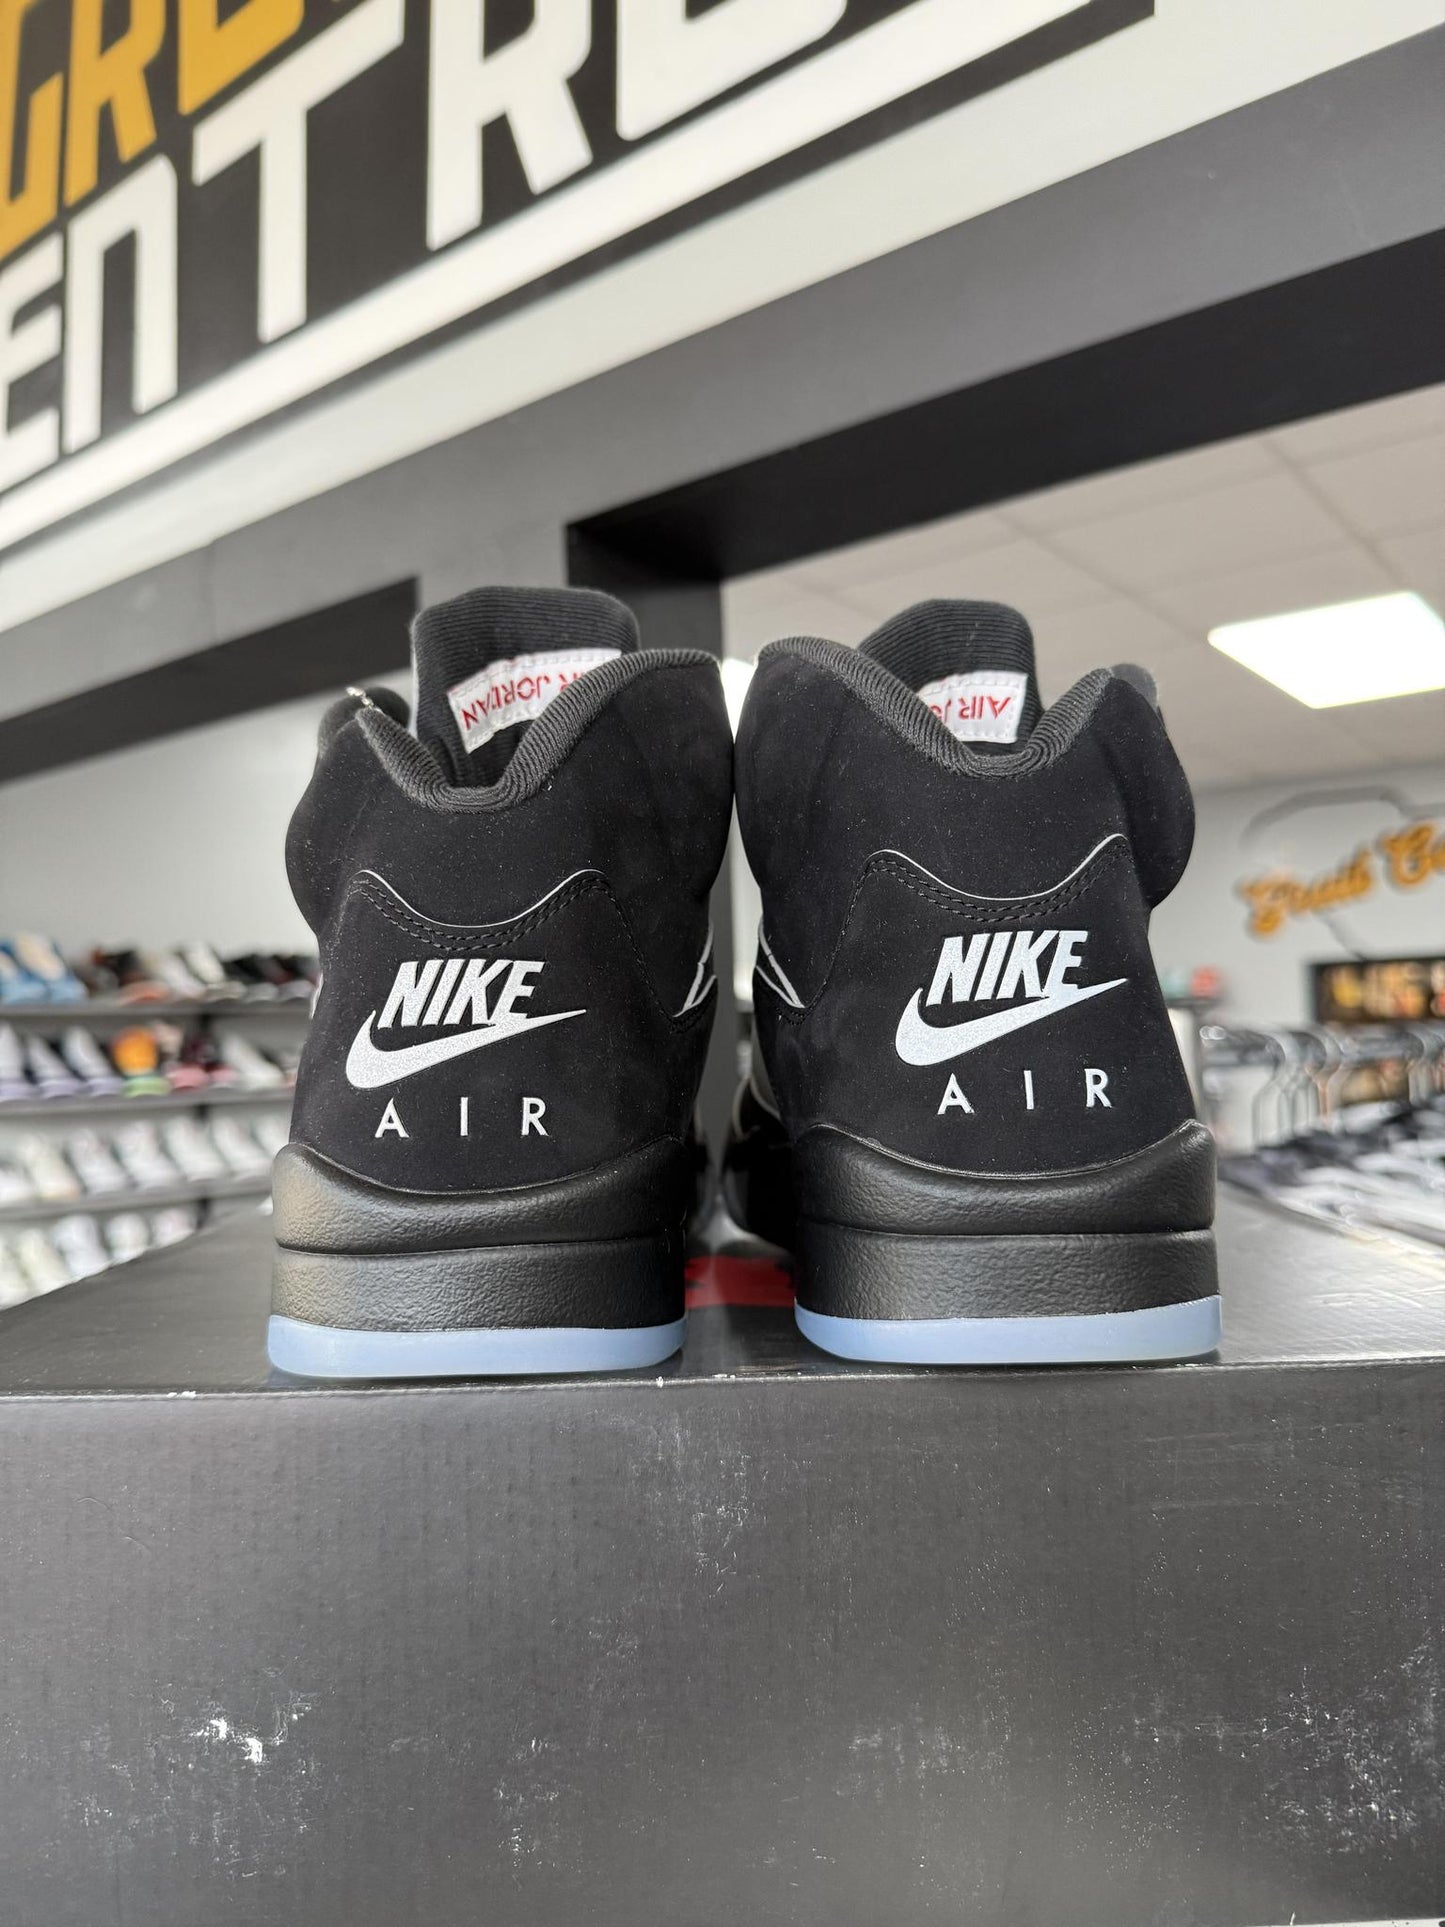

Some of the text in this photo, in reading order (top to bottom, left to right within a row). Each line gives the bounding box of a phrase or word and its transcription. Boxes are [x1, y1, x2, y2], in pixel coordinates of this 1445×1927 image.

[958, 696, 1011, 719] AIR
[932, 930, 1088, 1006] NIKE
[377, 958, 545, 1029] NIKE
[937, 1067, 1112, 1115] AIR
[374, 1096, 549, 1138] AIR
